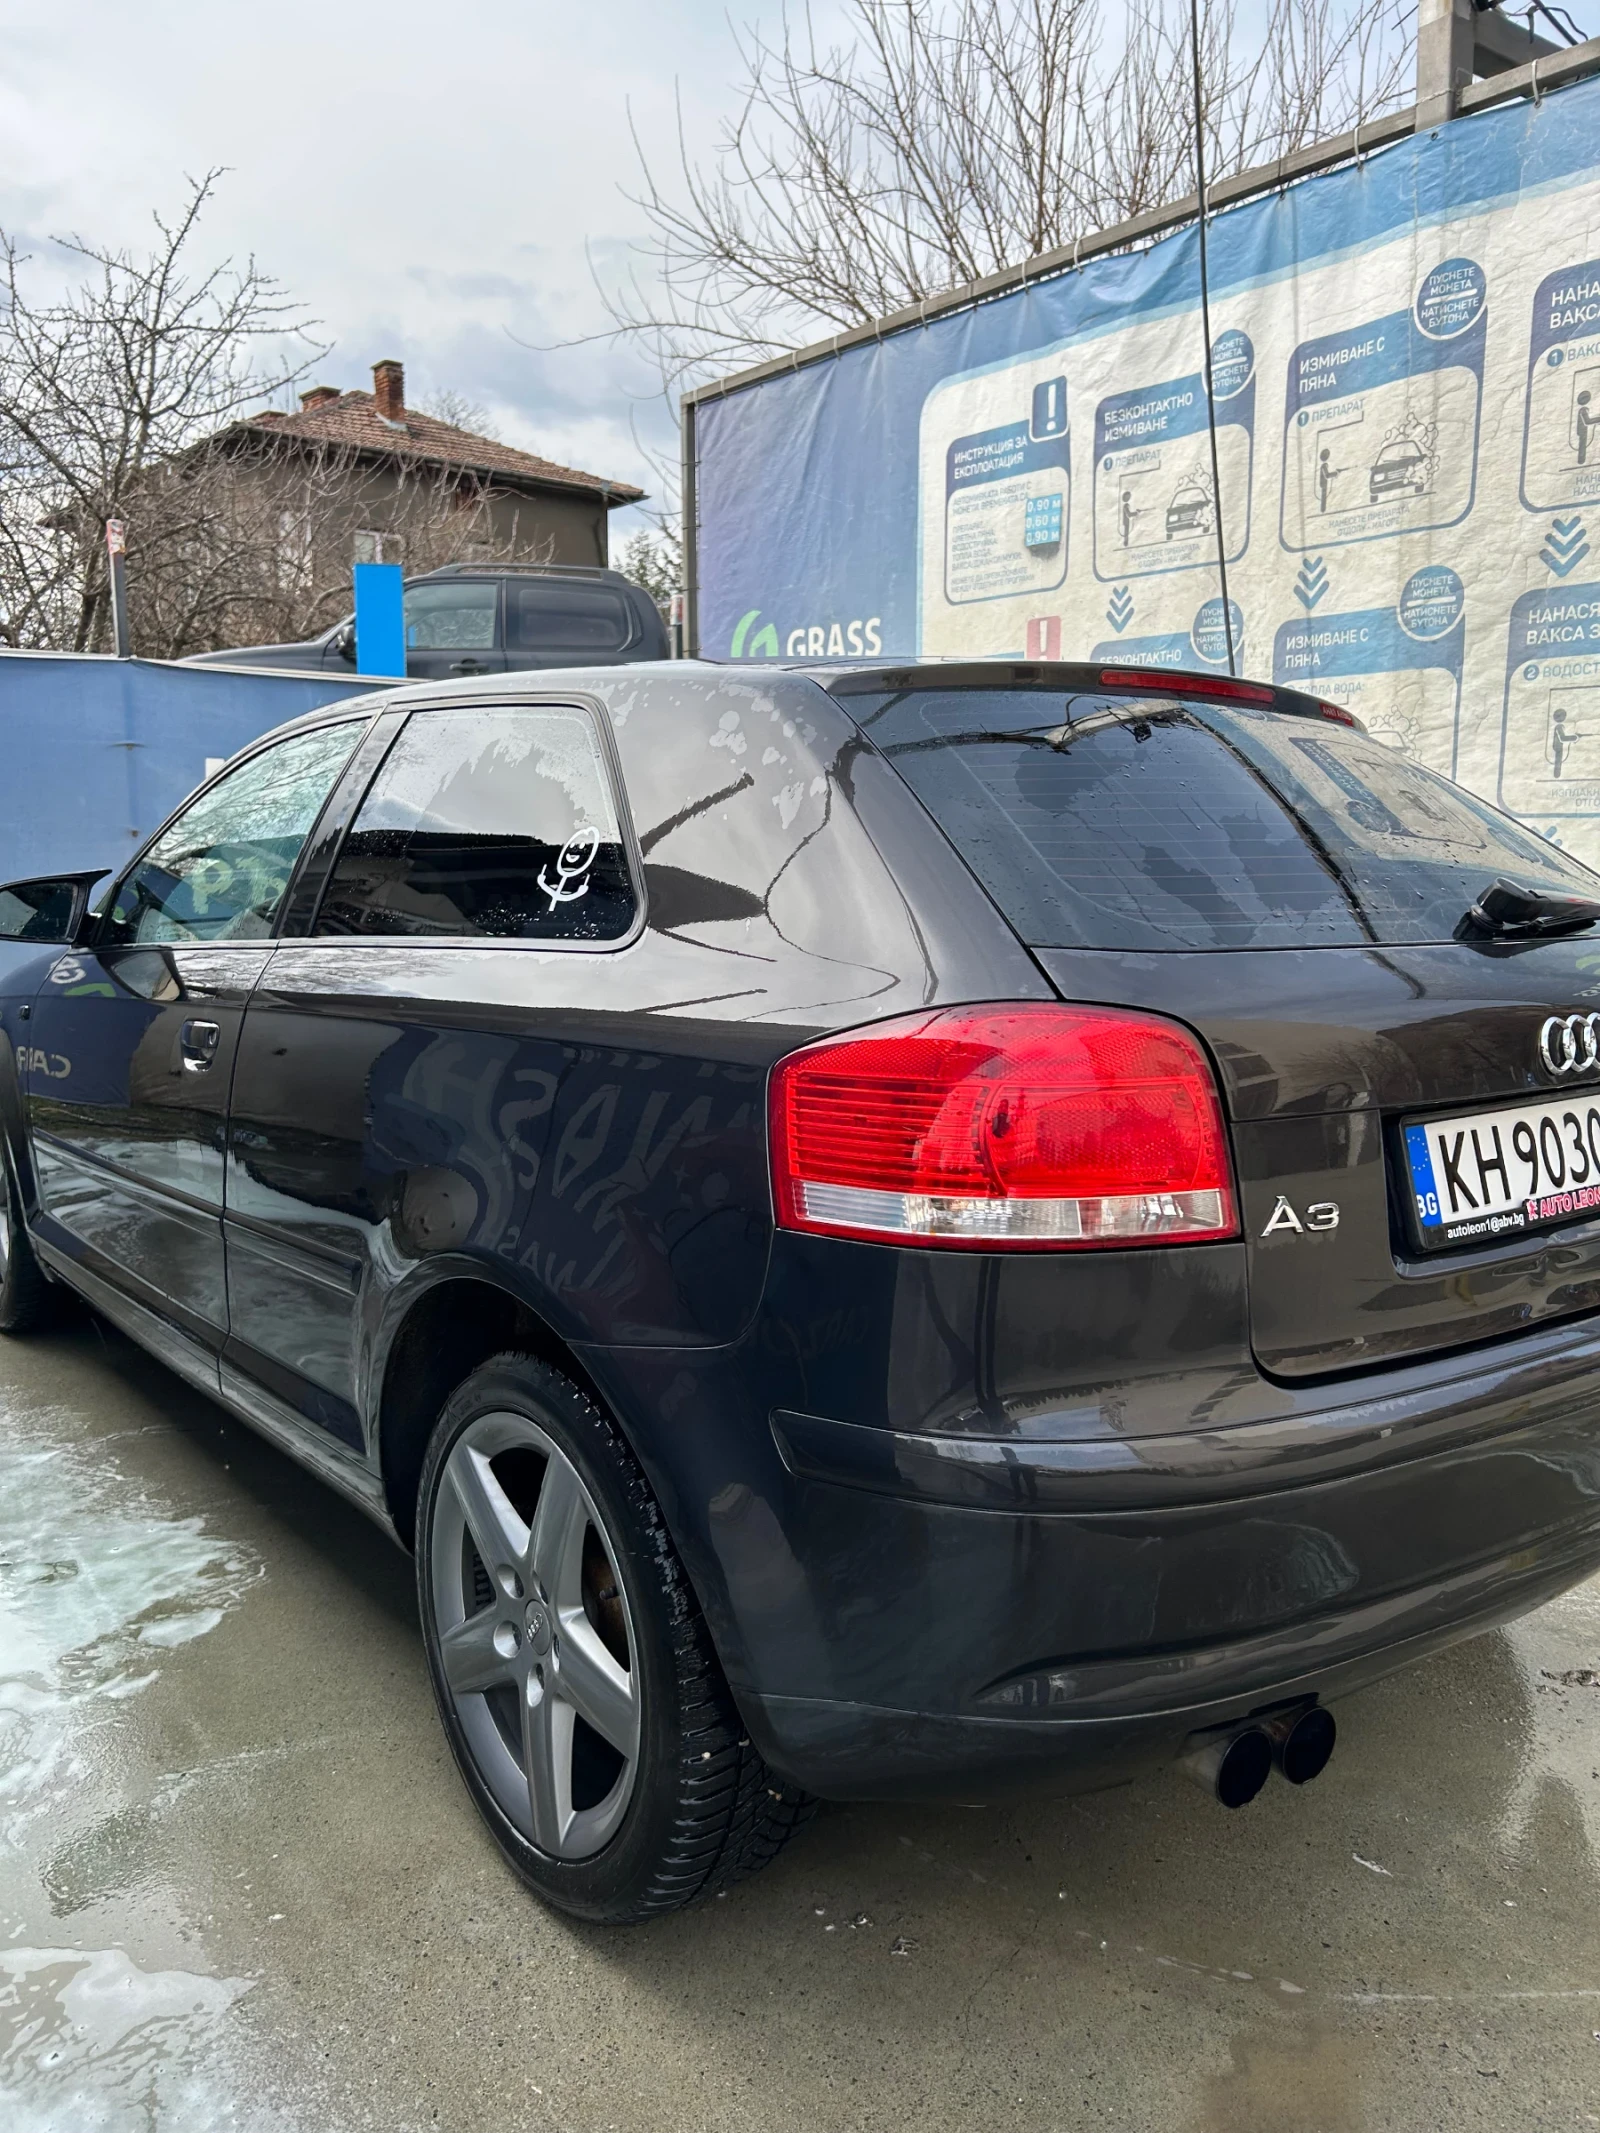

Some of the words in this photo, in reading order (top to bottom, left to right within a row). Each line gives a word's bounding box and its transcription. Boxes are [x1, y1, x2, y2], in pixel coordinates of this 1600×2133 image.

[1429, 266, 1476, 285] ПУСНЕТЕ
[1430, 279, 1472, 296] МОНЕТА
[1421, 297, 1479, 318] НАТИСНЕТЕ
[1429, 311, 1469, 328] БУТОНА
[1300, 341, 1375, 374] ИЗМИВАНЕ
[1376, 337, 1385, 352] С
[1211, 364, 1249, 380] АТИСНЕТЕ
[1300, 374, 1337, 393] ПЯНА
[1104, 392, 1193, 425] БЕЗКОНТАКТНО
[1312, 399, 1364, 422] ПРЕПАРАТ
[1104, 416, 1168, 442] ИЗМИВАНЕ
[954, 439, 1015, 464] ИНСТРУКЦИЯ
[1015, 435, 1028, 449] ЗА
[954, 451, 1024, 479] ЕКСПЛОАТАЦИЯ
[1411, 574, 1454, 589] ПУСНЕТЕ
[1413, 586, 1451, 598] МОНЕТА
[1404, 604, 1457, 619] НАТИСНЕТЕ
[1411, 616, 1448, 628] БУТОНА
[787, 617, 882, 656] GRASS
[1286, 631, 1357, 650] ИЗМИВАНЕ
[1360, 628, 1369, 642] С
[1526, 625, 1585, 645] ВАКСА
[1203, 642, 1228, 652] БУТОН
[1285, 653, 1321, 668] ПЯНА
[1417, 1192, 1437, 1218] BG
[1438, 1126, 1511, 1213] KH
[1260, 1195, 1340, 1237] A3
[1540, 1197, 1574, 1219] AUTO
[1447, 1213, 1525, 1239] autoleon1@abv.bg
